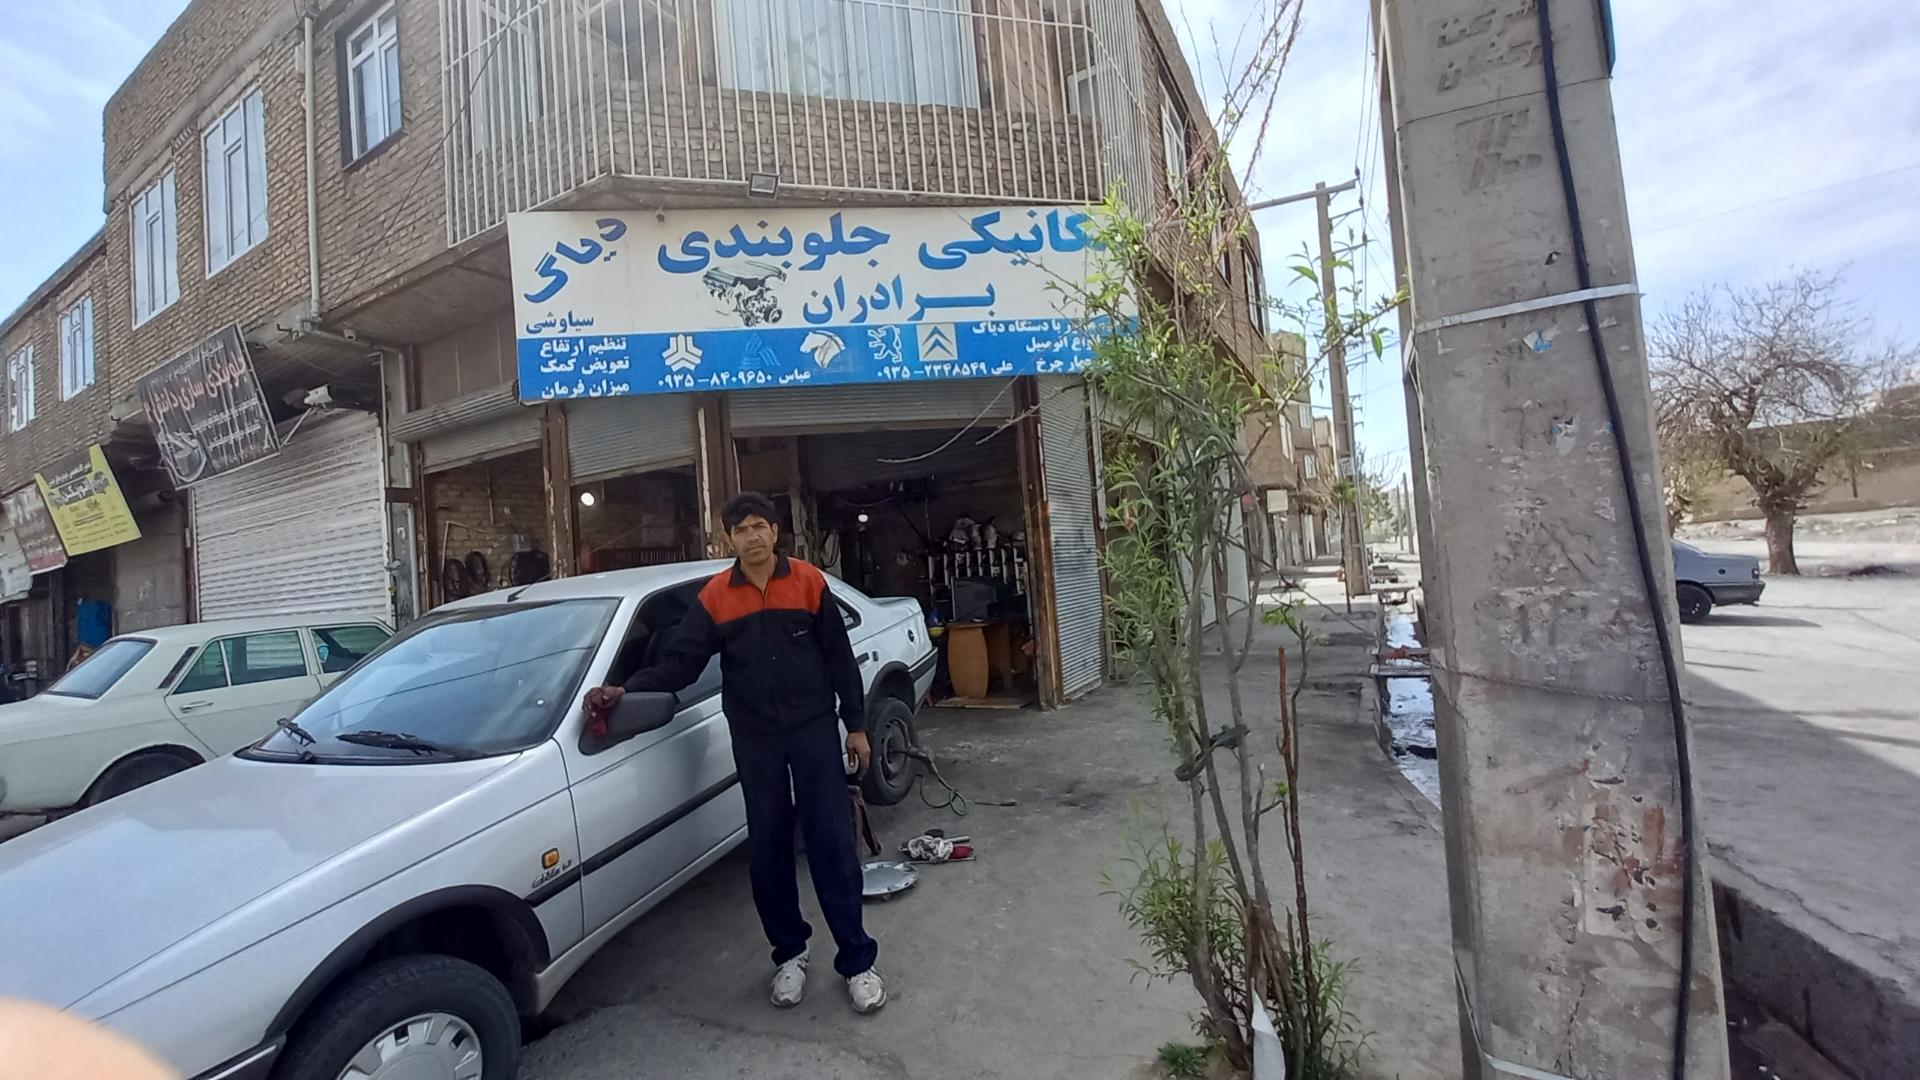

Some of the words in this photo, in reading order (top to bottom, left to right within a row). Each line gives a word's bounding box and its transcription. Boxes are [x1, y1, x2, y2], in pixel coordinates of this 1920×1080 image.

[657, 211, 891, 274] جلوبندی
[918, 208, 1108, 270] کانیکی
[524, 217, 628, 304] دیاگ
[803, 274, 997, 325] برادران
[526, 310, 595, 334] سیاوشی
[1008, 319, 1049, 333] دستگاه
[1052, 319, 1062, 332] با
[539, 338, 585, 358] ارتفاع
[588, 336, 628, 356] تنظیم
[1025, 334, 1069, 353] اتومبیل
[539, 357, 577, 374] کمک
[581, 355, 631, 376] تعویض
[991, 360, 1014, 375] علی
[1036, 356, 1065, 374] چرخ
[778, 368, 812, 385] عباس
[541, 379, 586, 400] فرمان
[588, 377, 631, 397] میزان
